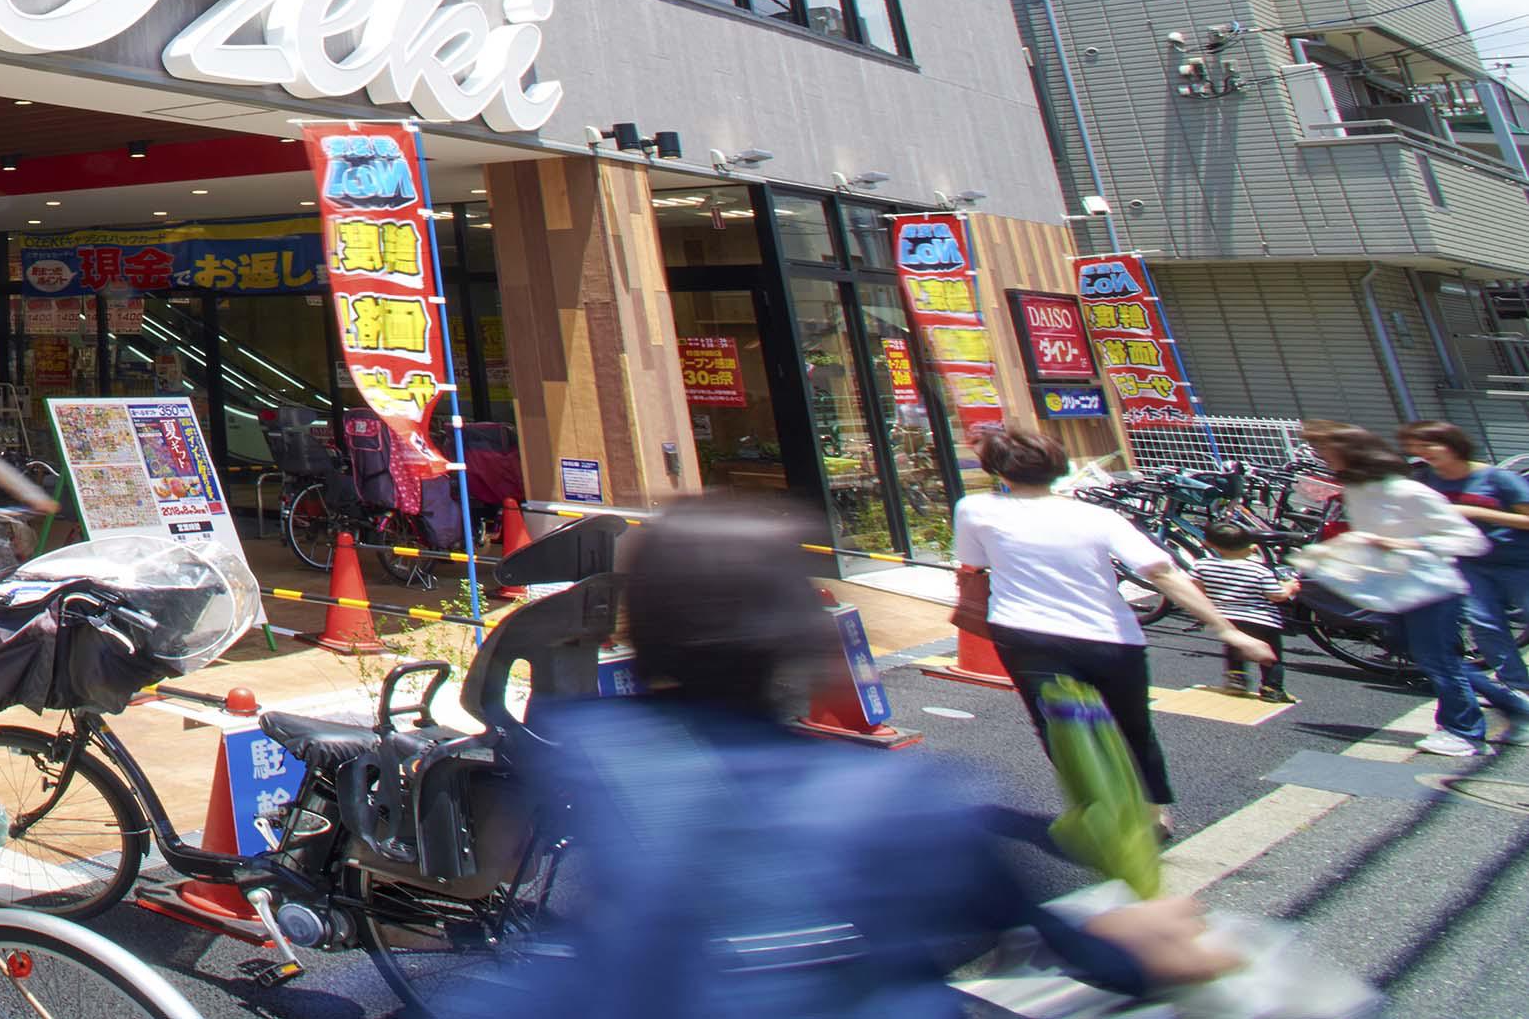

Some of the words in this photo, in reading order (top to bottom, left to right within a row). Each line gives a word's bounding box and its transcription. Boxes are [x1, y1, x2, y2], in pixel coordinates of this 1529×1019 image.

[1027, 306, 1073, 328] DAISO
[1039, 337, 1079, 362] ダイソー
[158, 405, 179, 417] 350
[1061, 394, 1099, 409] クリーニング
[160, 419, 186, 469] 夏ギフト
